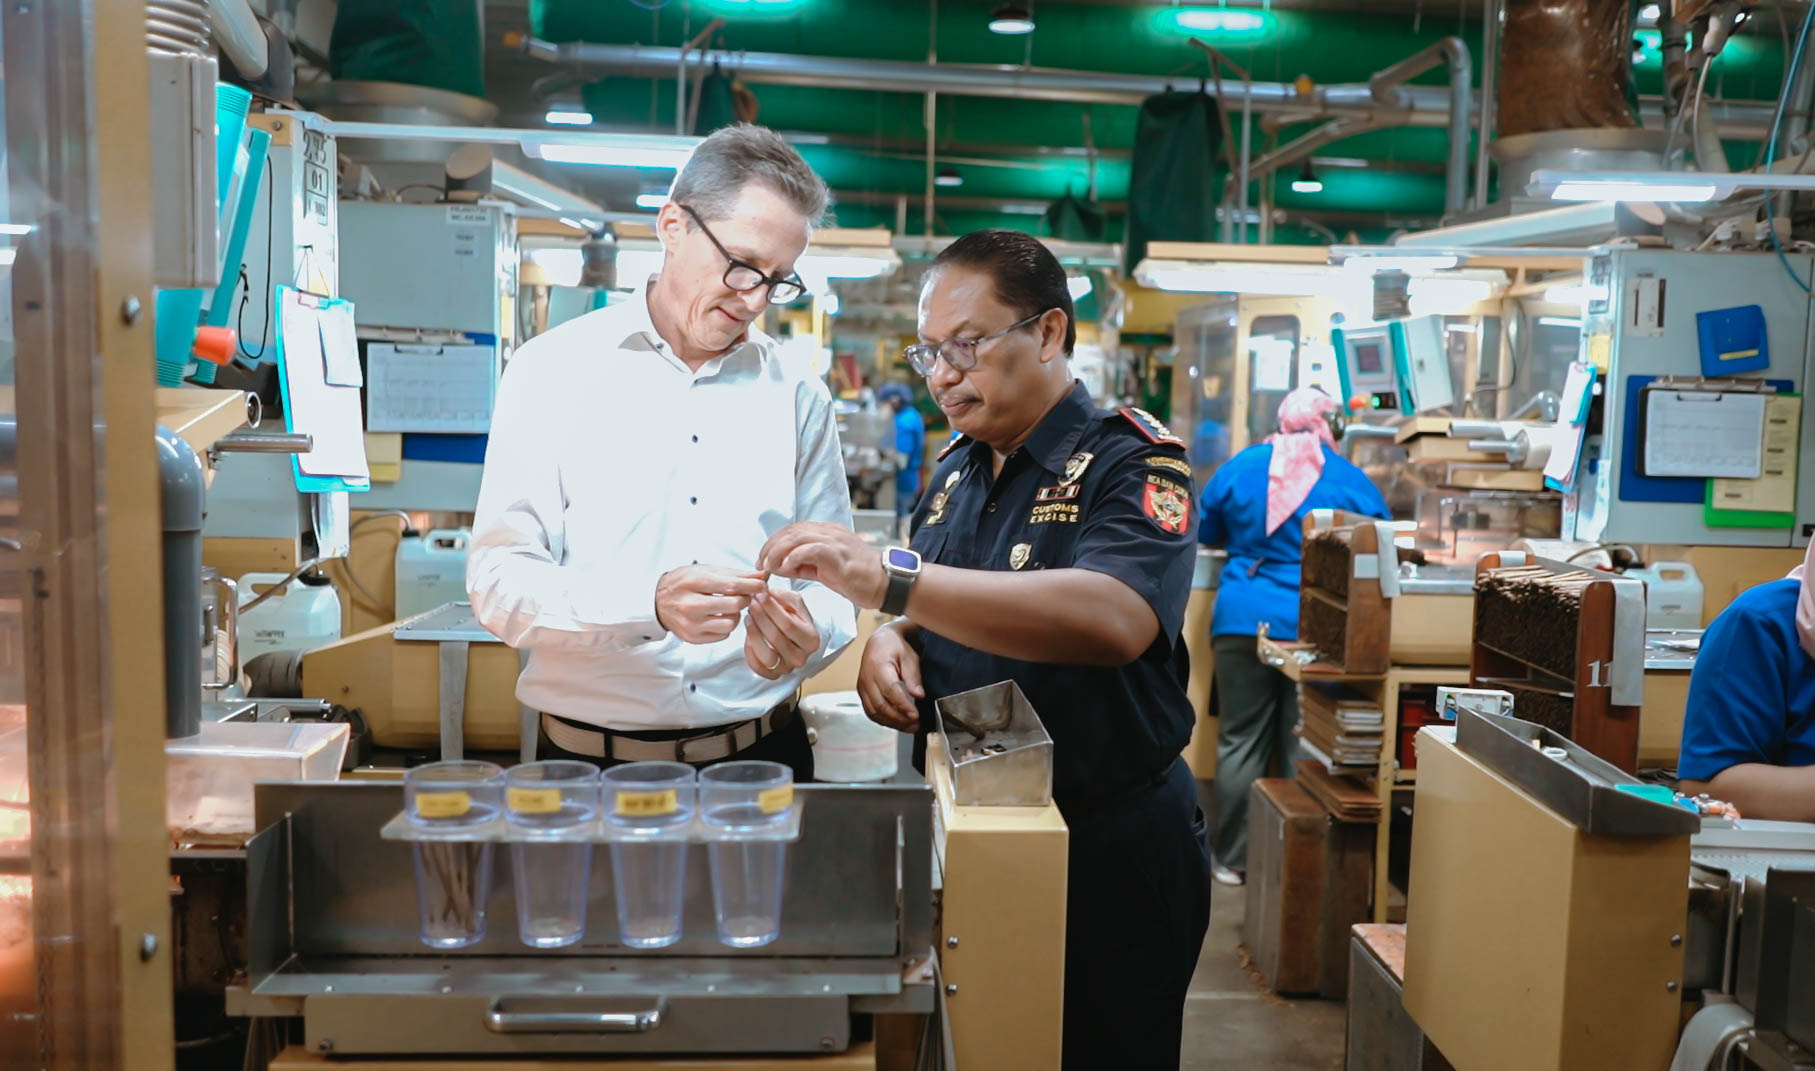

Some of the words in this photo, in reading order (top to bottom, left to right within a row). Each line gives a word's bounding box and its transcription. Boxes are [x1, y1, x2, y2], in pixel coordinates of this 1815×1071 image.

[311, 169, 322, 191] 01
[1032, 503, 1079, 514] CUSTOMS
[1030, 512, 1078, 523] EXCISE
